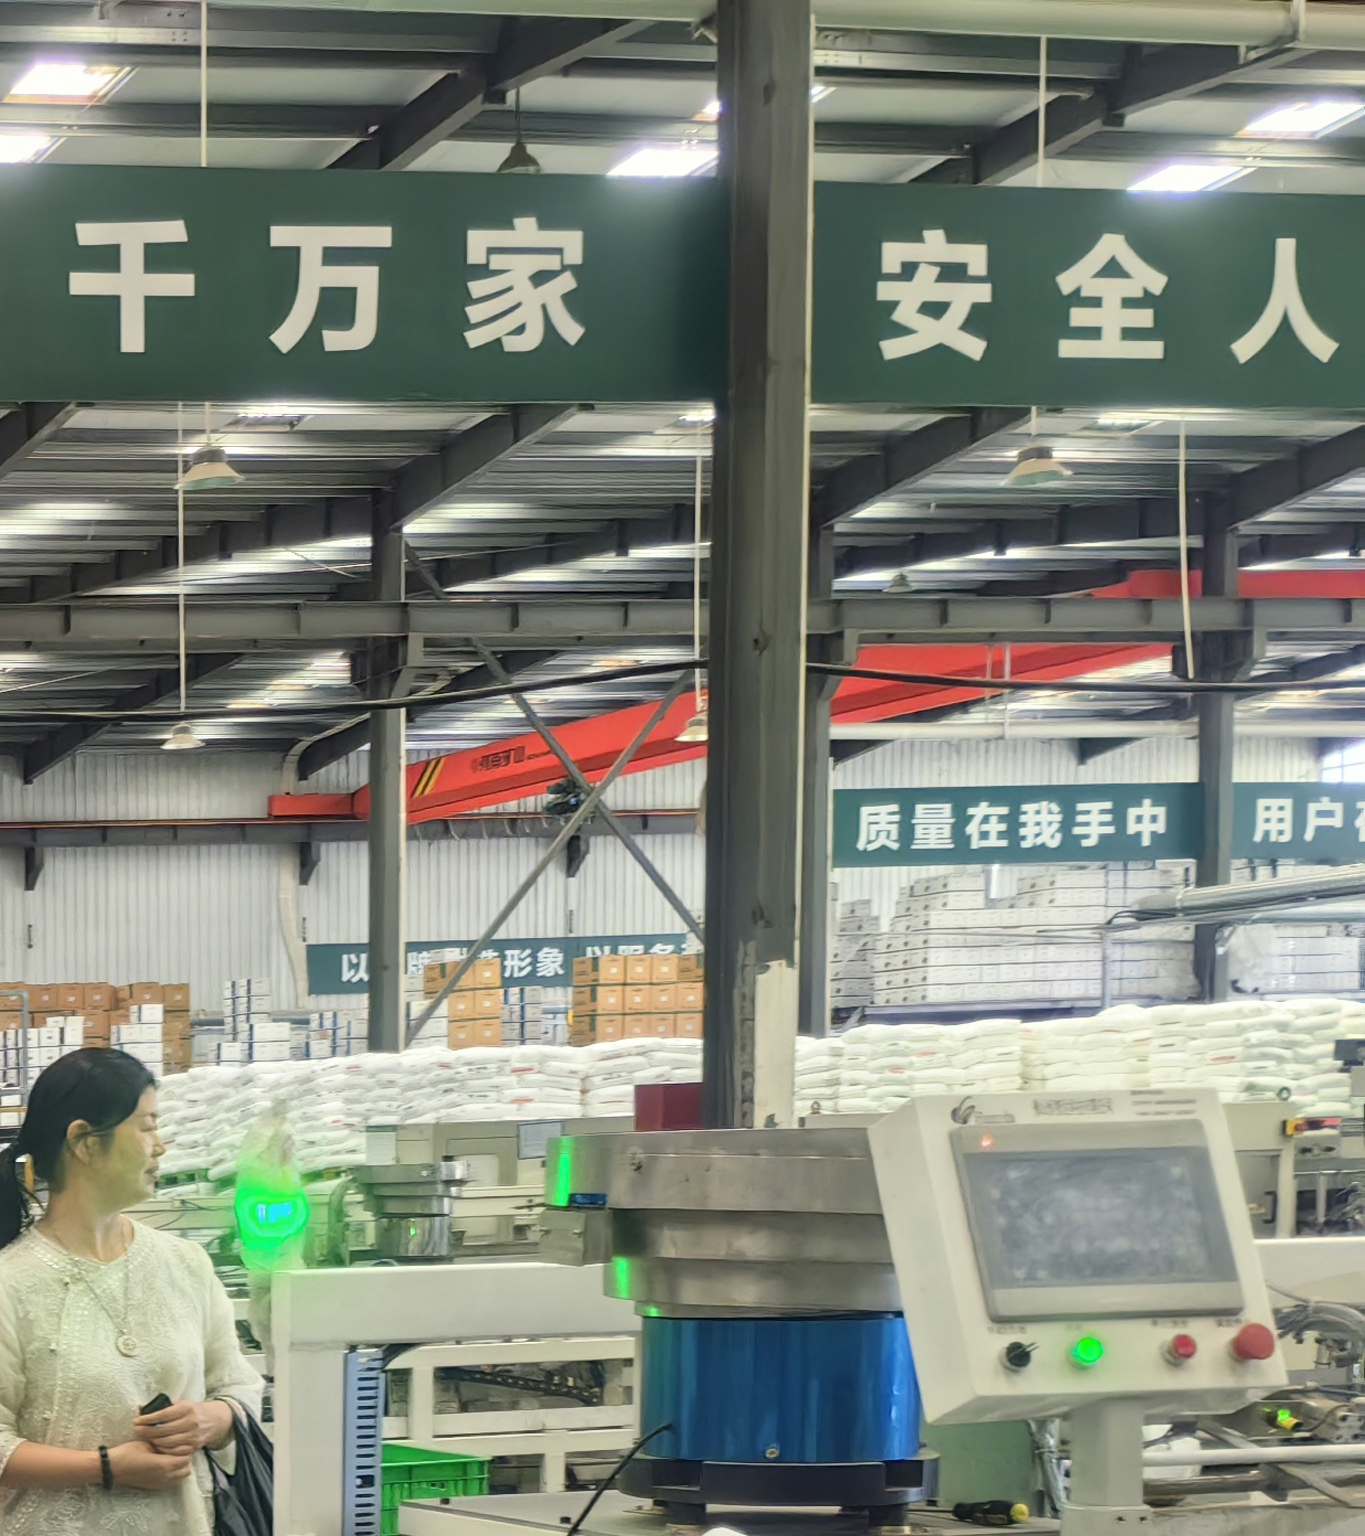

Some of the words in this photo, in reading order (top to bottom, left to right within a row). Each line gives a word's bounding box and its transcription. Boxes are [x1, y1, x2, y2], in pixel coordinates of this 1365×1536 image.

[875, 227, 1340, 366] 安全人
[855, 797, 1169, 855] 质量在我手中
[1253, 795, 1365, 848] 用户
